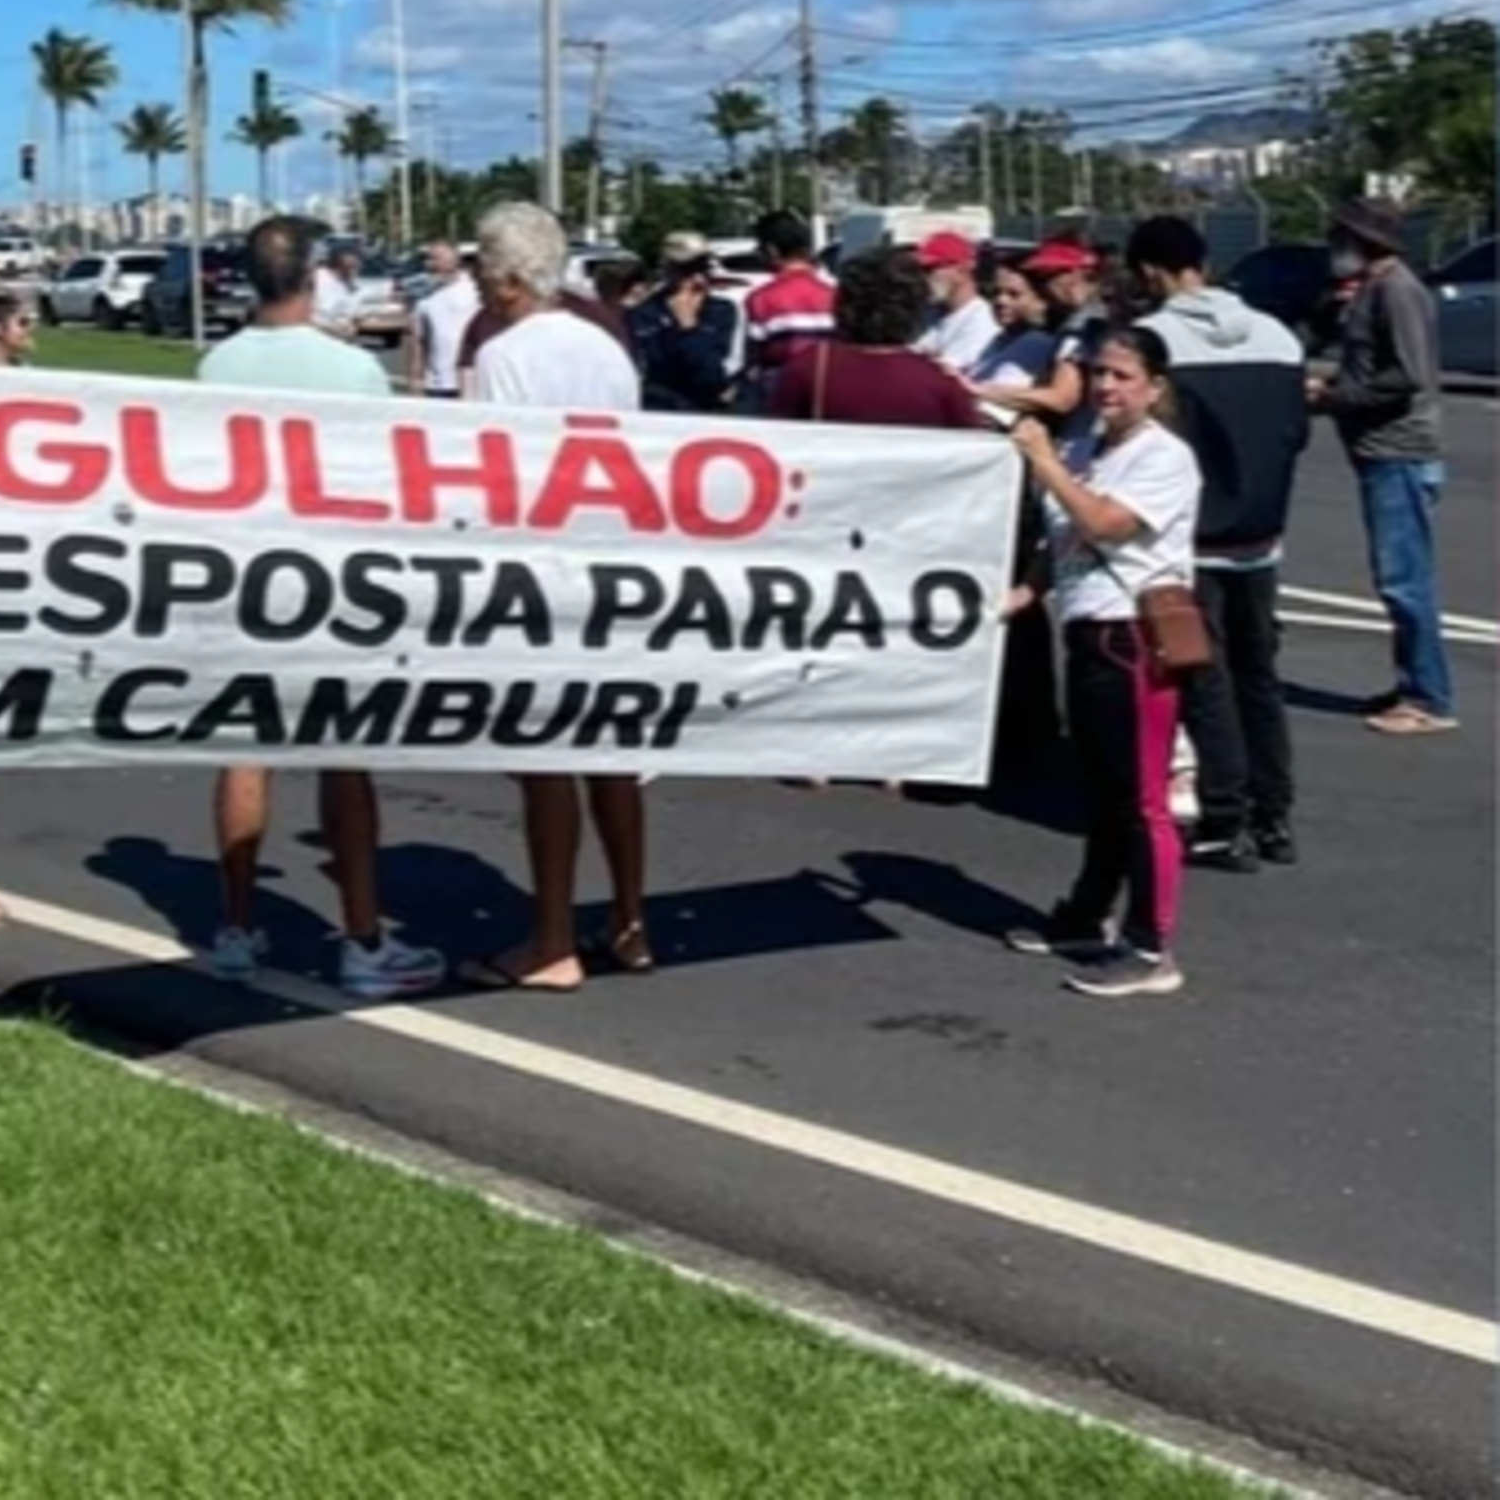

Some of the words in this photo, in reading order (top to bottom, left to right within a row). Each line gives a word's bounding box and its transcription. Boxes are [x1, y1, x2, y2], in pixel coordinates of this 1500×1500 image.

[580, 563, 887, 652] PARA
[907, 568, 984, 651] O
[90, 667, 701, 749] CAMBURI
